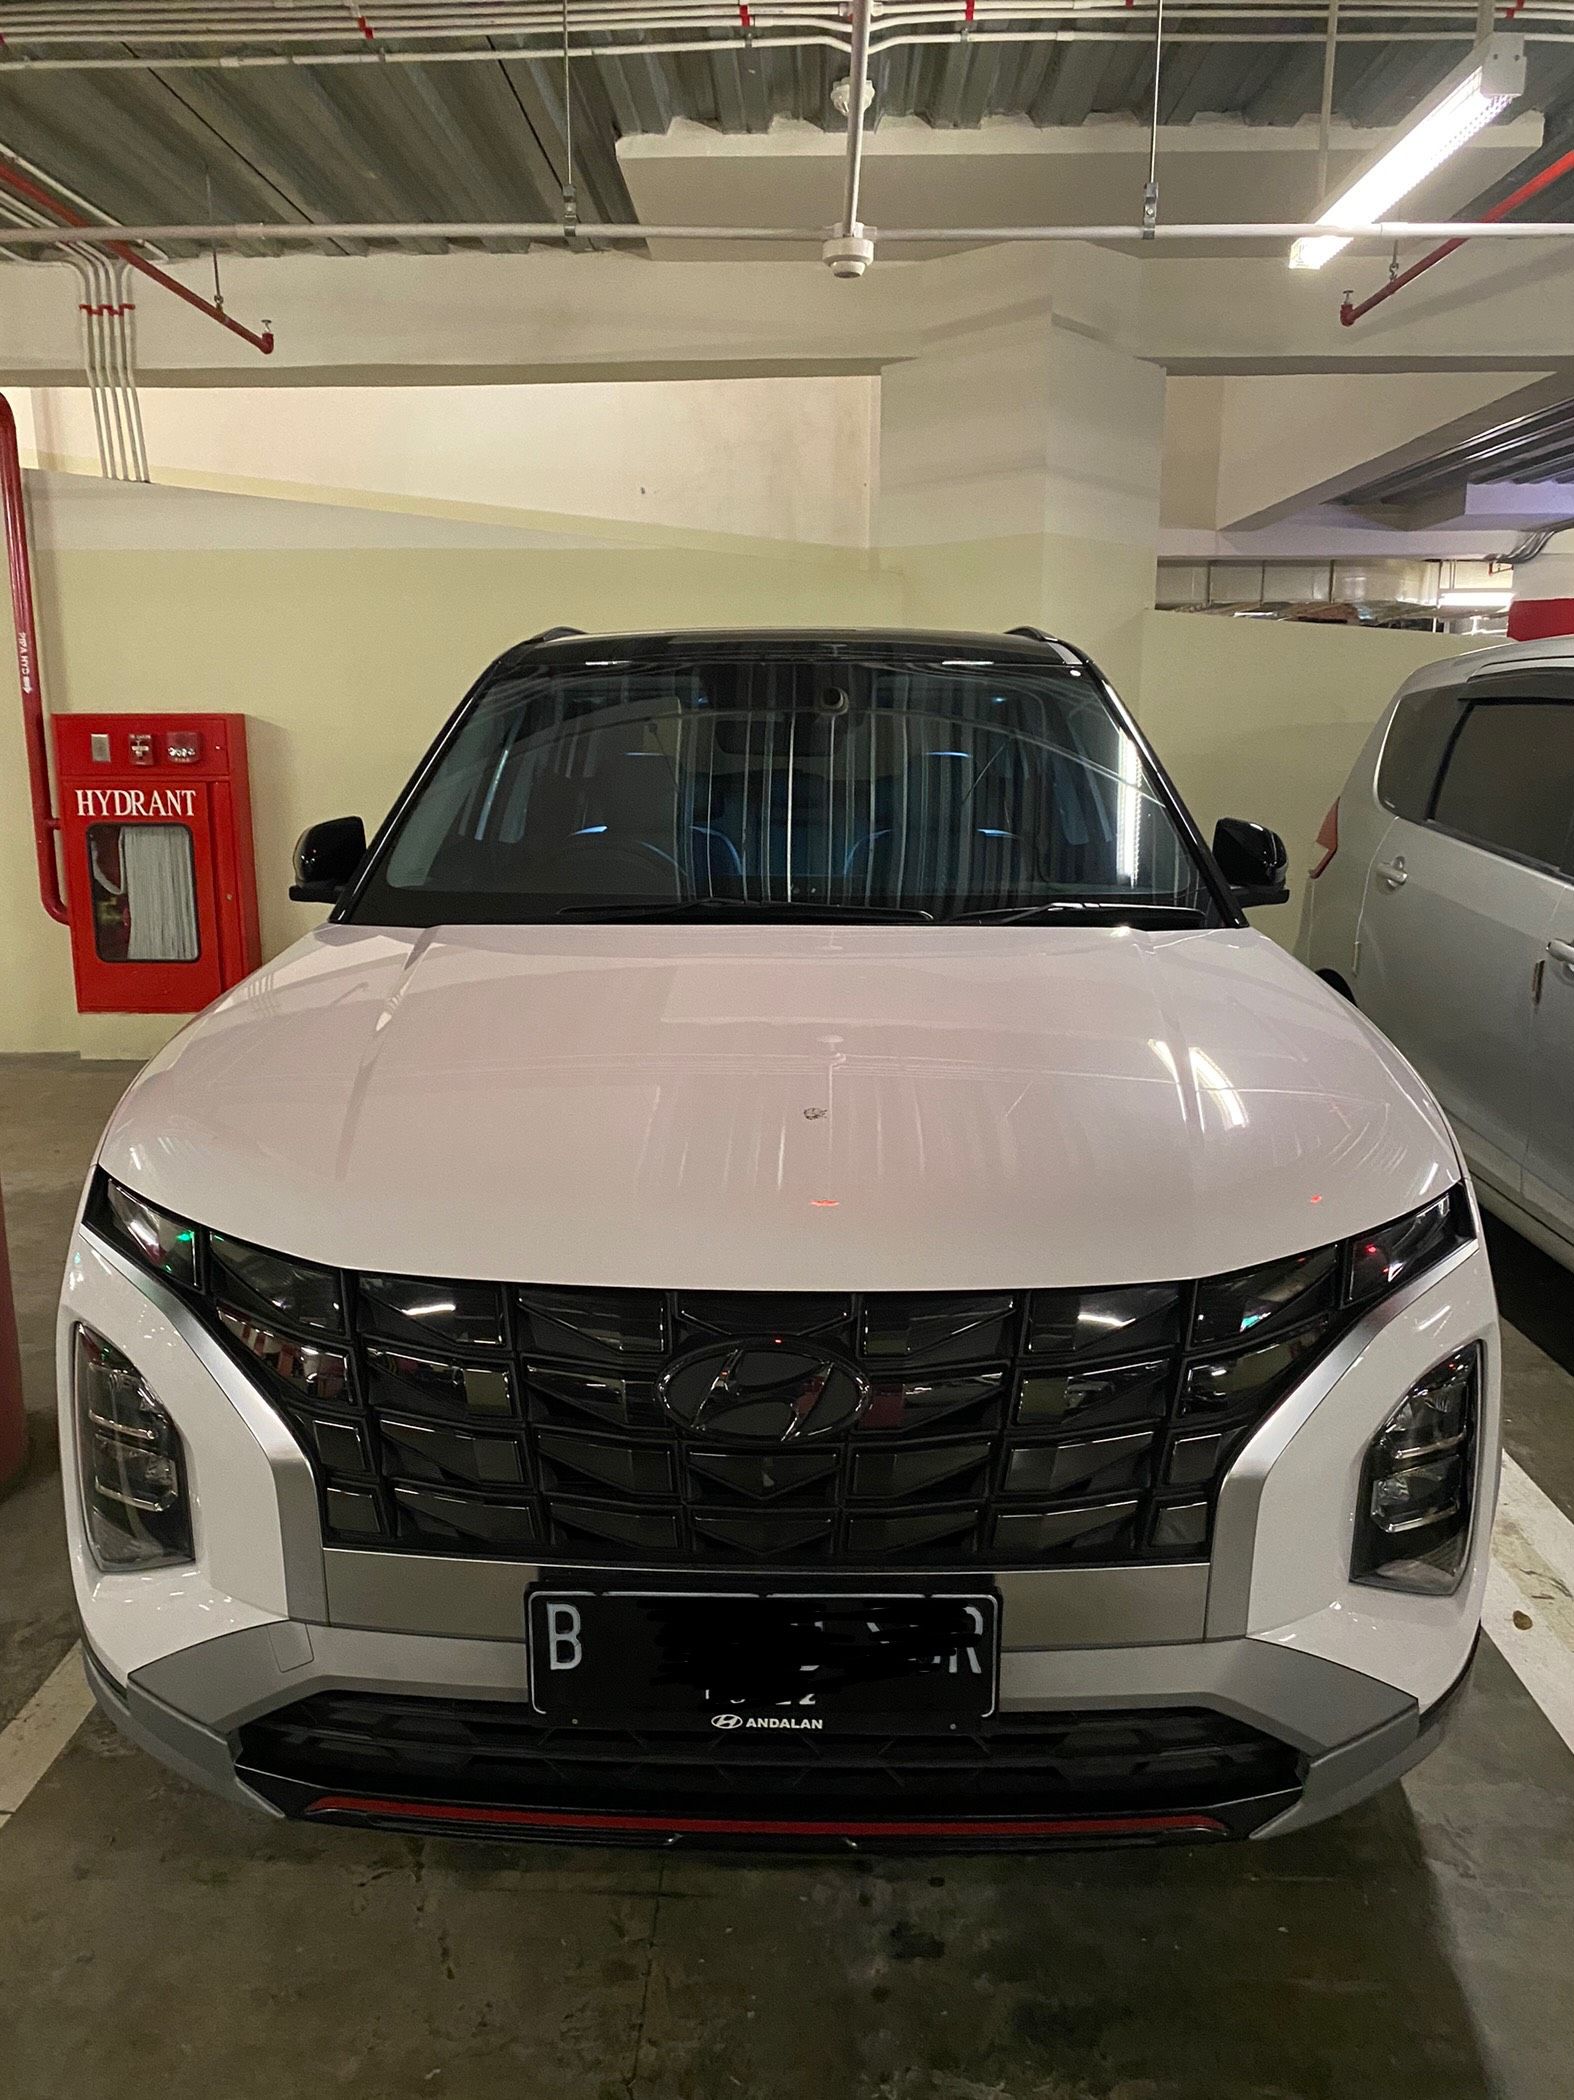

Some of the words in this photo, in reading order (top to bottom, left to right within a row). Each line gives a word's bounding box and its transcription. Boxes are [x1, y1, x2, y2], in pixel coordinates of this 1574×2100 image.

[75, 789, 196, 817] HYDRANT
[547, 1602, 582, 1670] B
[746, 1718, 823, 1729] ANDALAN
